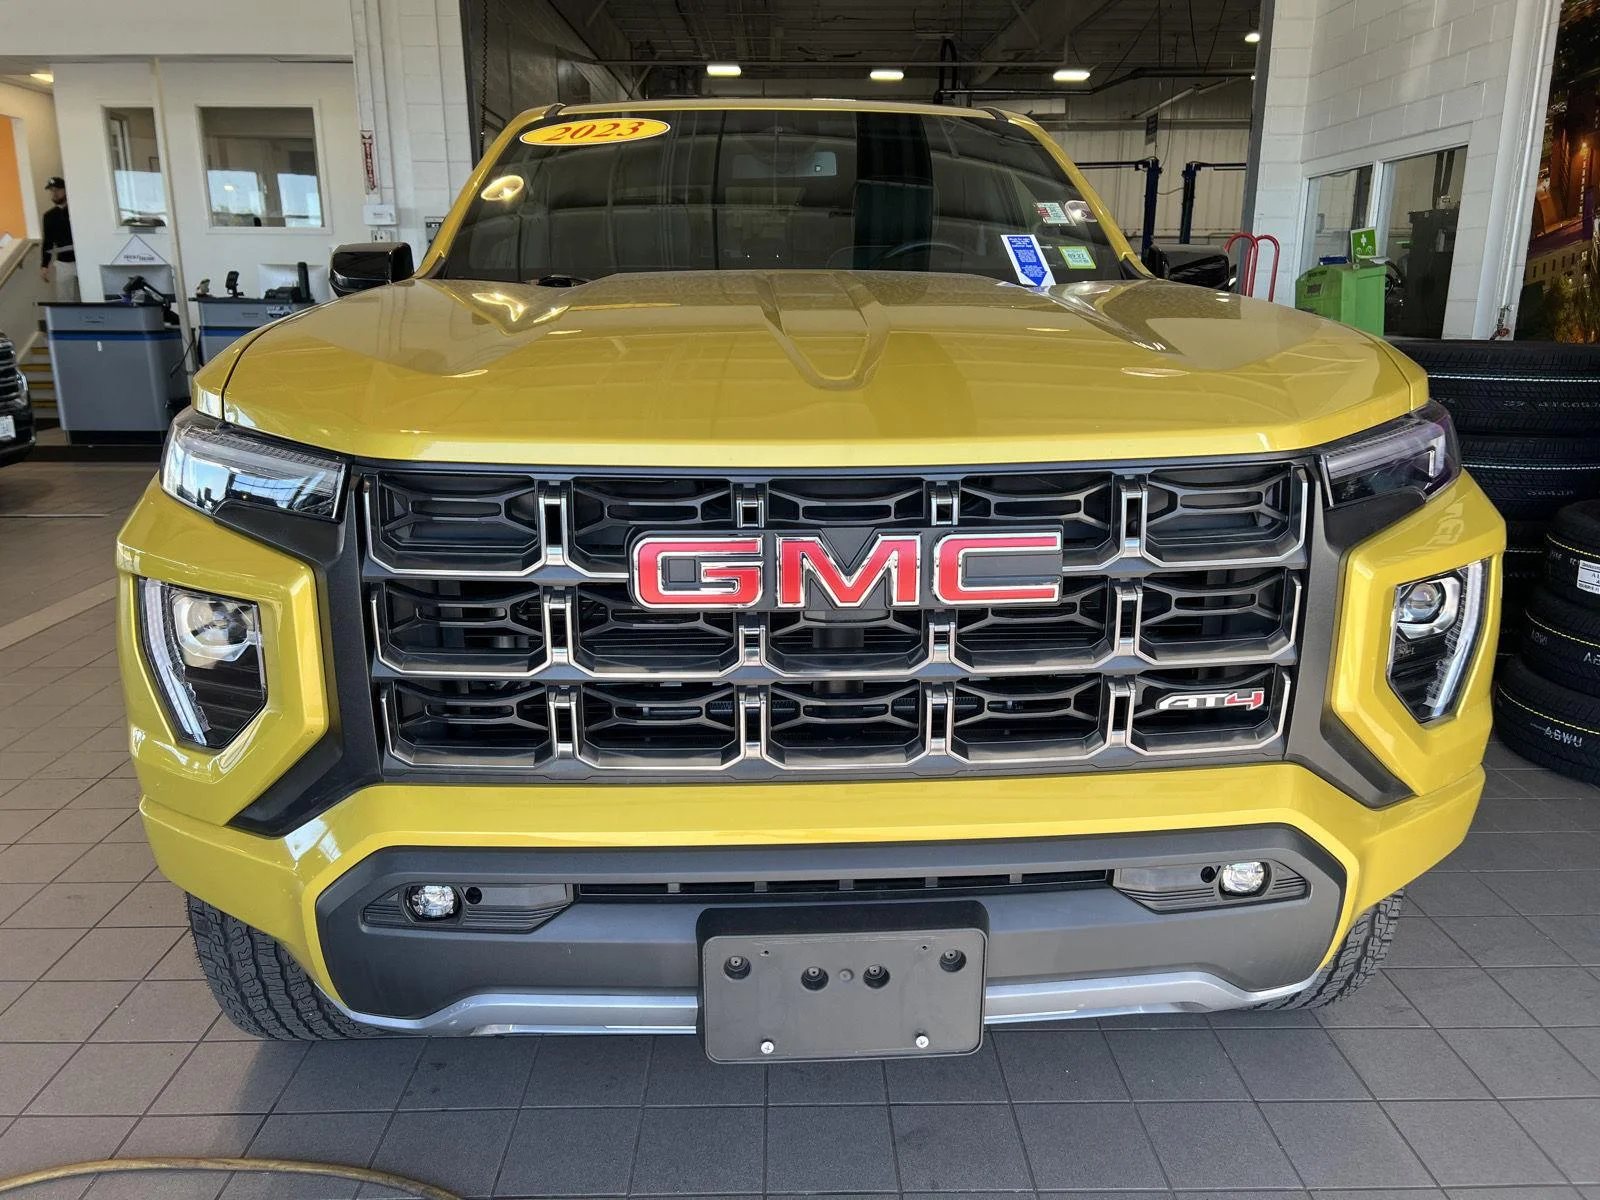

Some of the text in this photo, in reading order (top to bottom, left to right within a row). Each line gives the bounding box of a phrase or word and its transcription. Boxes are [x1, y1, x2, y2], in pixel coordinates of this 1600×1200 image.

[543, 121, 645, 142] 2023
[632, 531, 1063, 609] GMC
[1158, 689, 1265, 711] AT4
